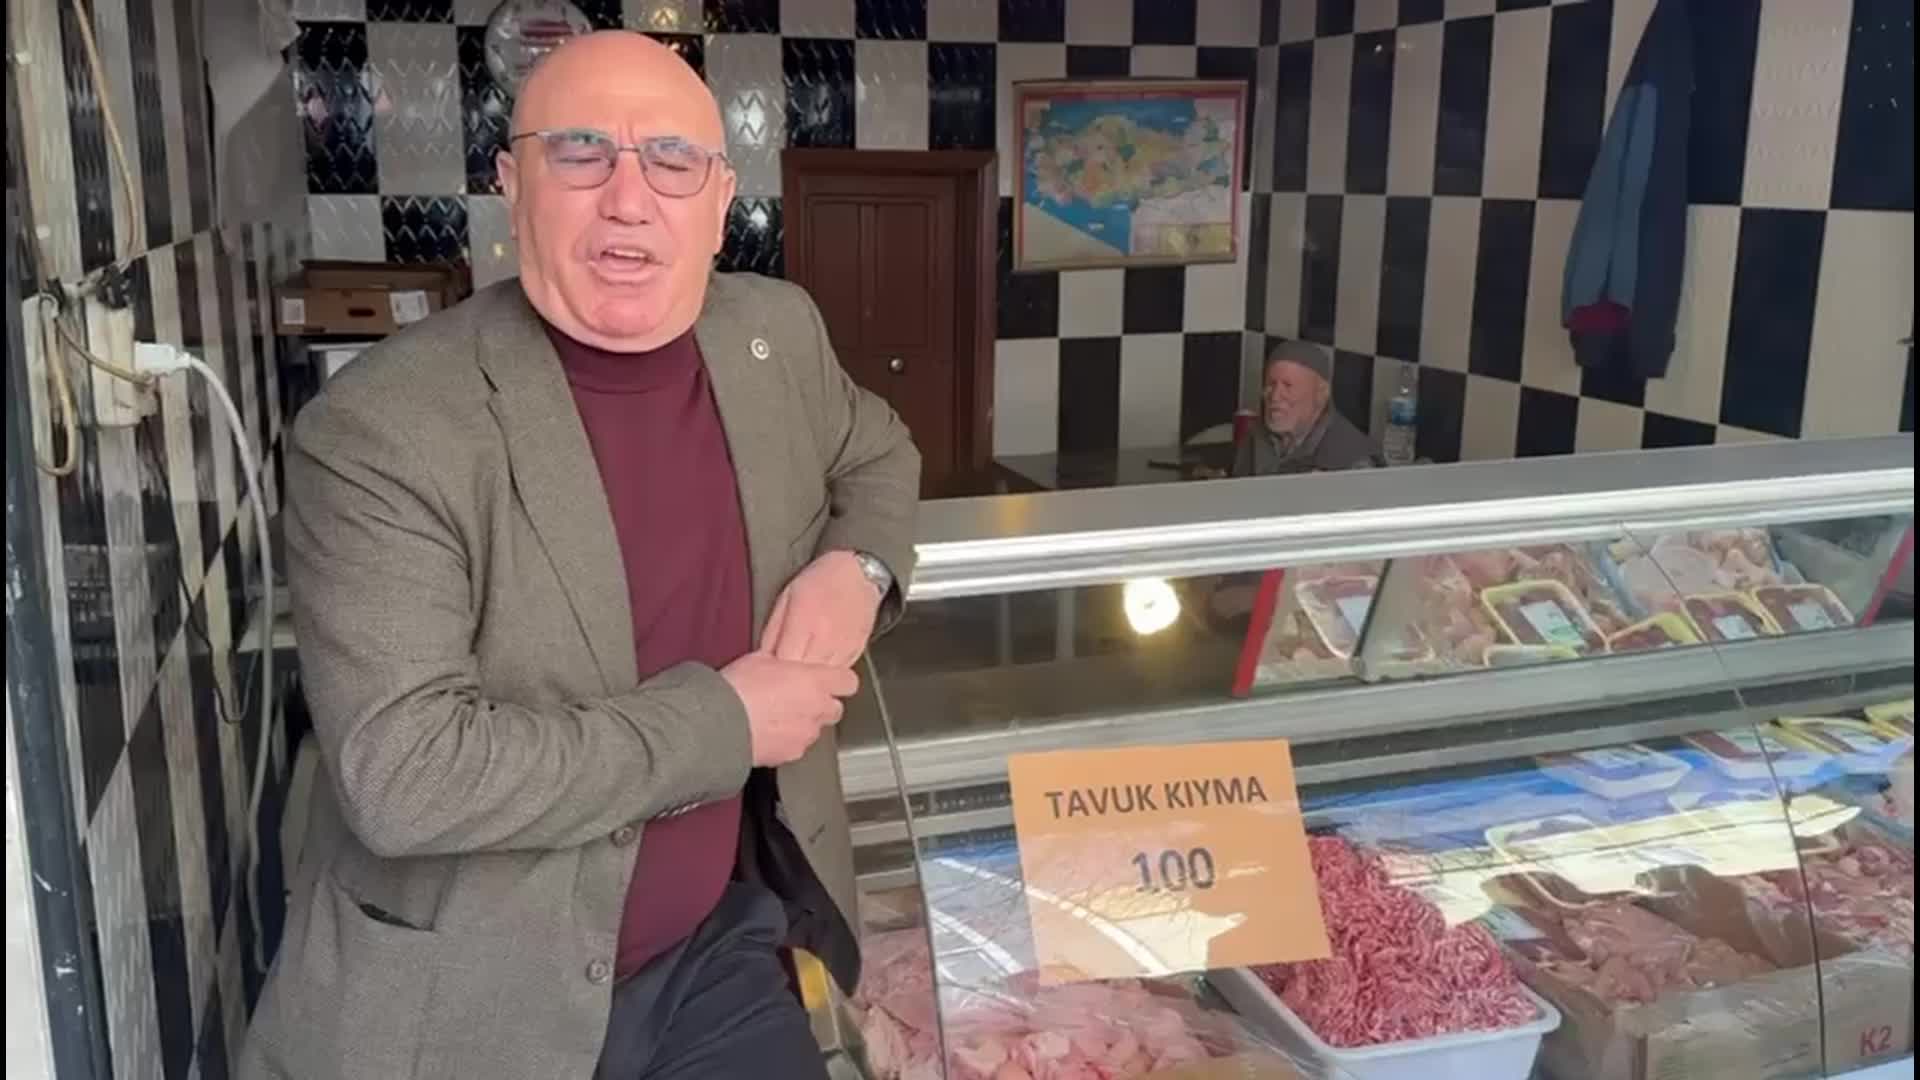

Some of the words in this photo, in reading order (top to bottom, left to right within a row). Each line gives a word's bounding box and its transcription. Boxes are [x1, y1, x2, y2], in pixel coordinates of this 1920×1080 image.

[1044, 783, 1159, 819] TAVUK
[1164, 775, 1269, 809] KIYMA
[1131, 847, 1217, 894] 100
[1860, 1024, 1893, 1056] K2
